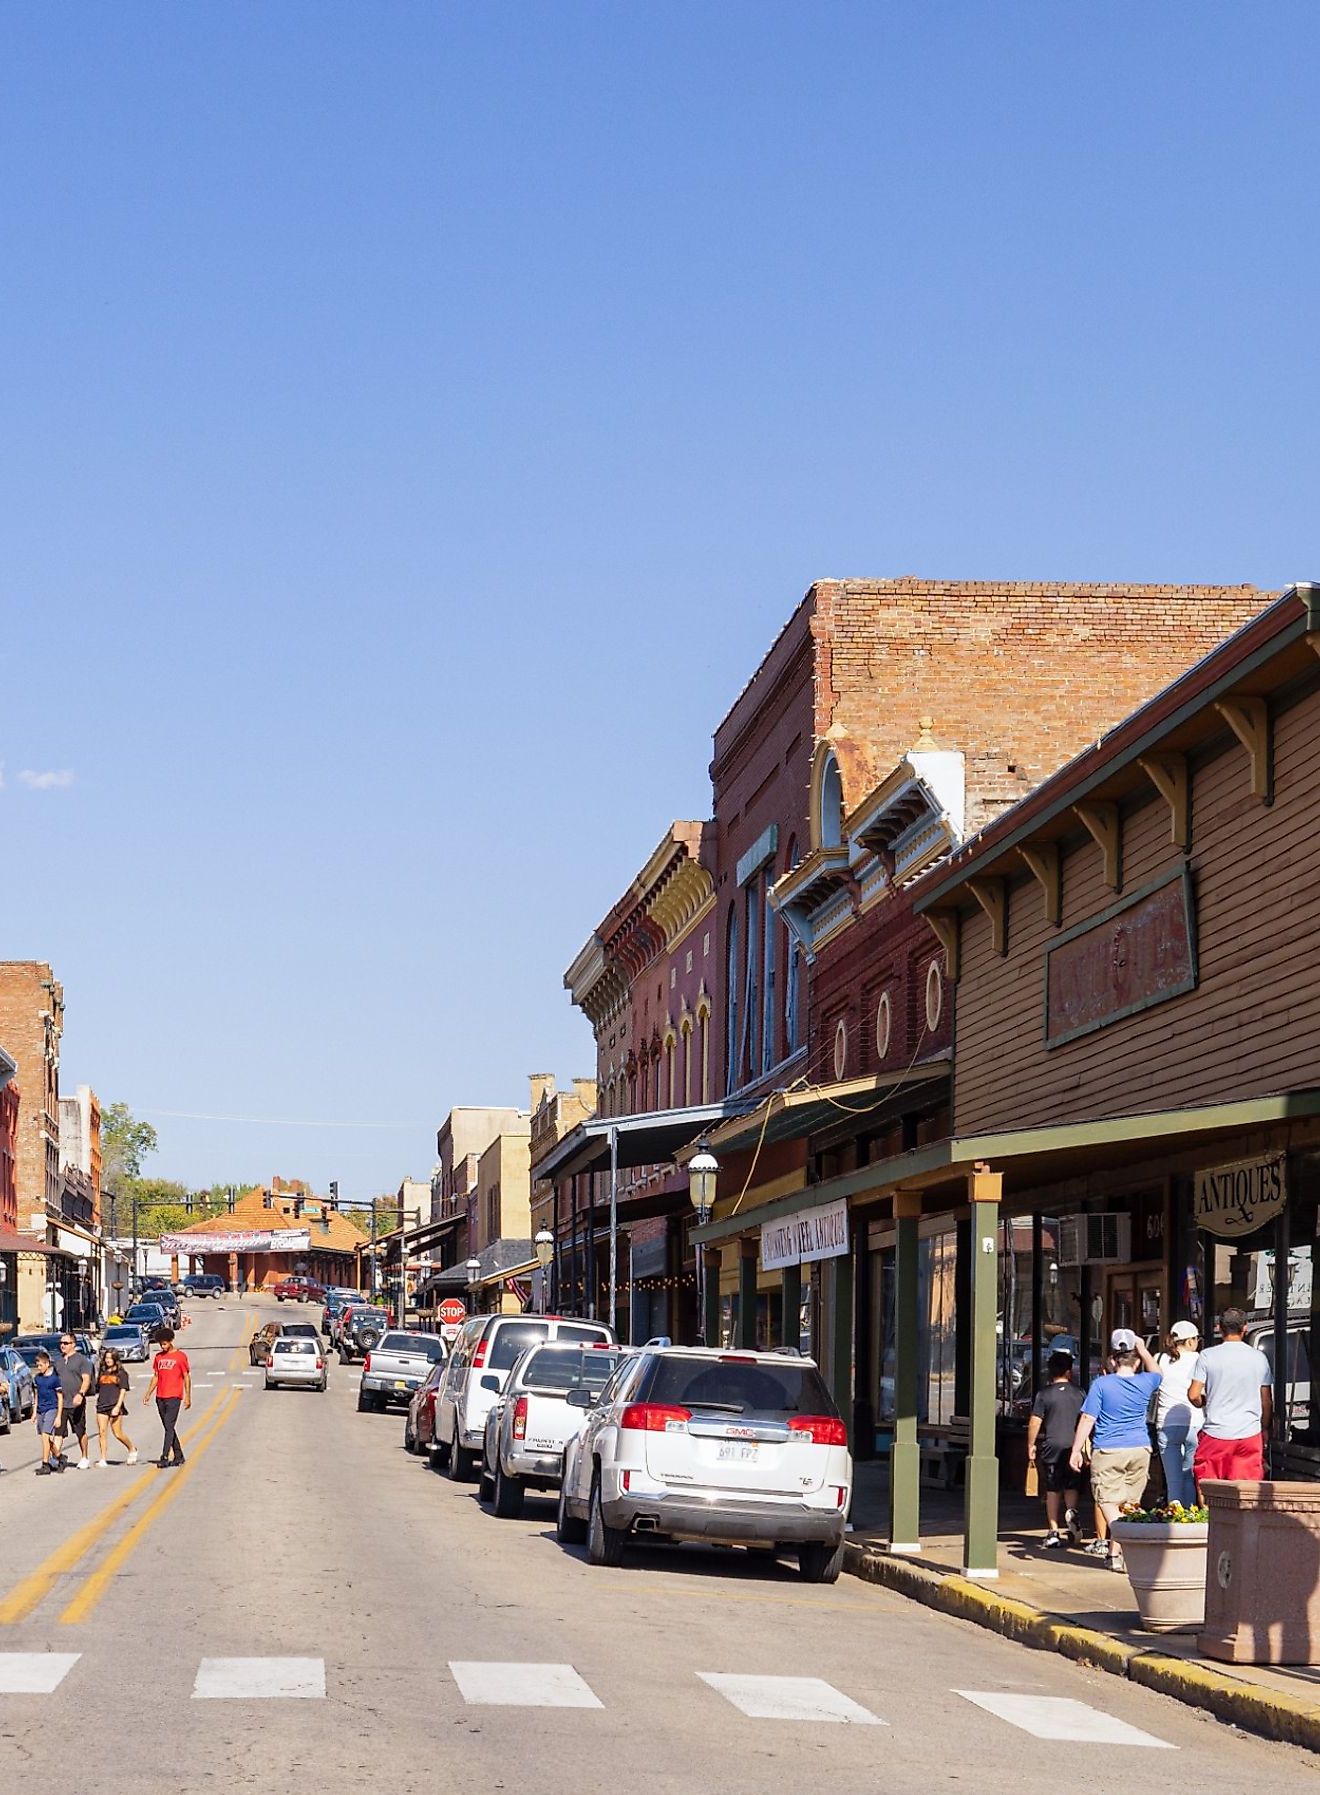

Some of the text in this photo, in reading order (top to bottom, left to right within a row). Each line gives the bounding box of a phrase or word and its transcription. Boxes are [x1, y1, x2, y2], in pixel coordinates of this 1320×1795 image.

[1199, 1163, 1281, 1221] ANTIQUES
[440, 1307, 463, 1317] STOP
[726, 1428, 754, 1437] GMC
